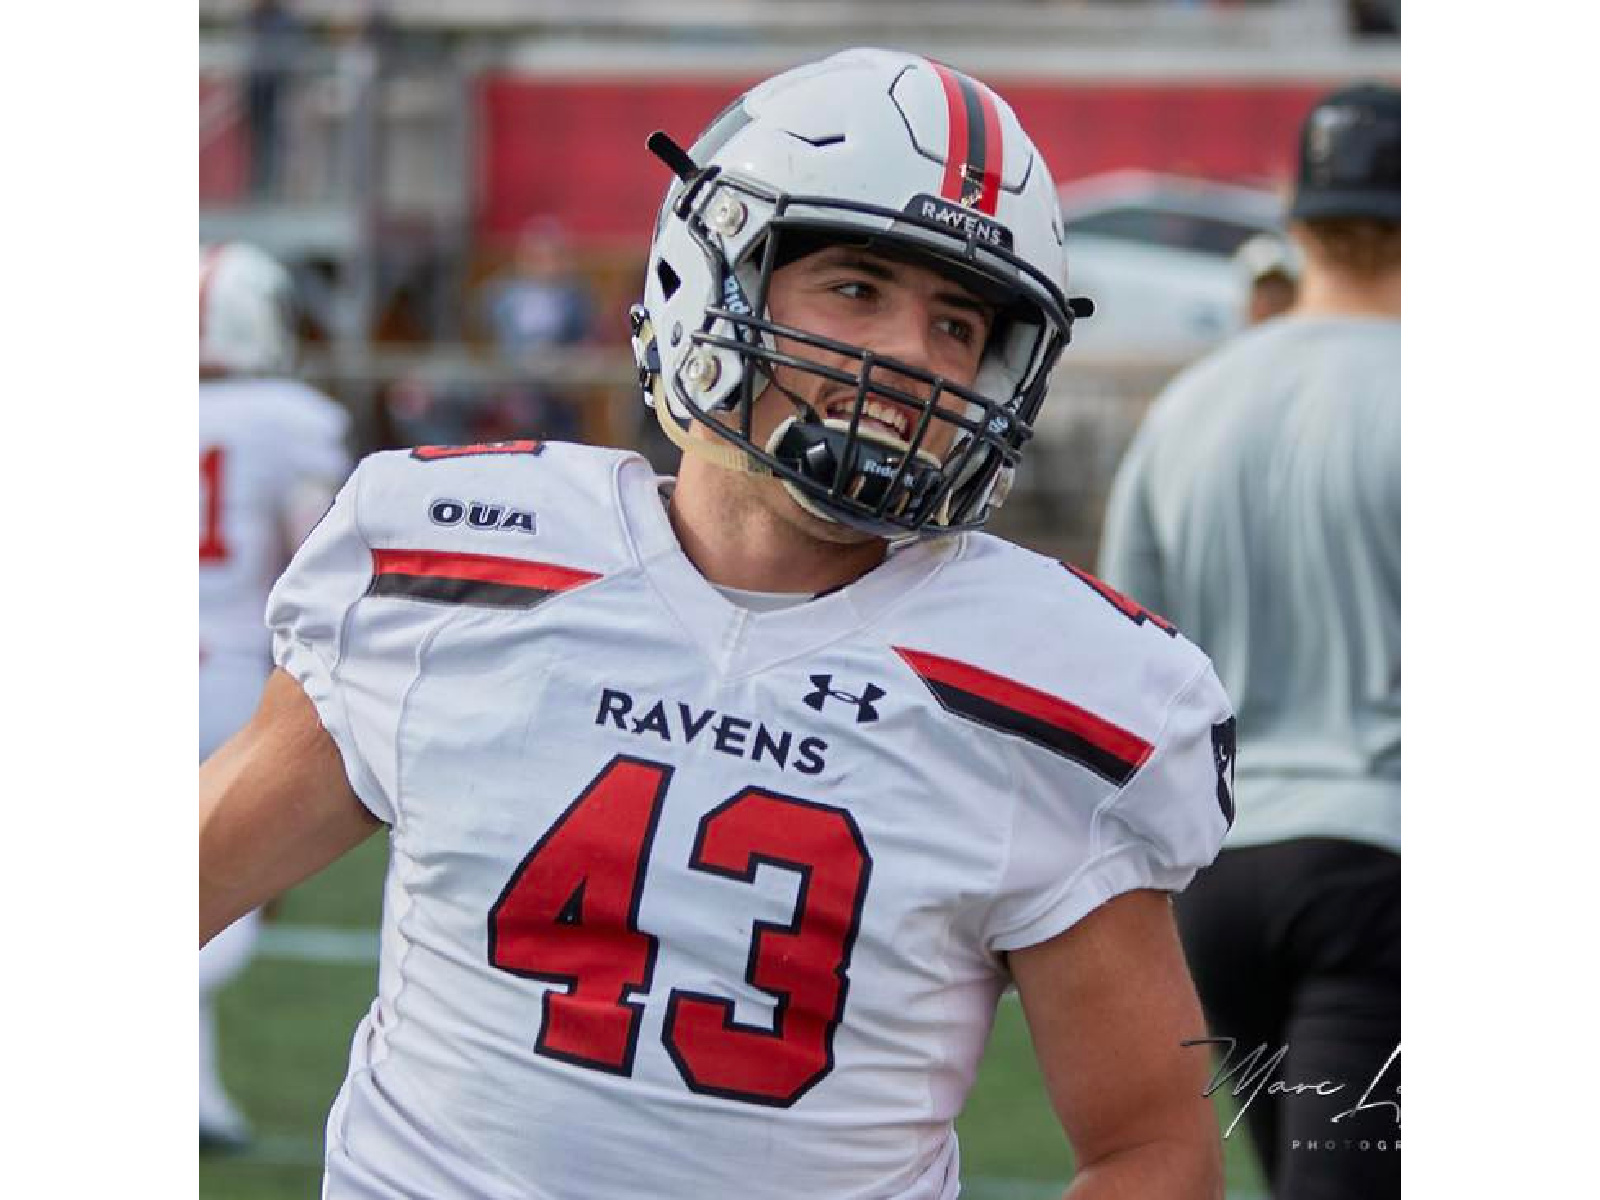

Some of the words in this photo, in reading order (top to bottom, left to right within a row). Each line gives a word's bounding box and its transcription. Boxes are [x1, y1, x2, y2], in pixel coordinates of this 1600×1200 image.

[921, 200, 1001, 246] RAVENS
[428, 498, 538, 535] OUA
[595, 687, 828, 775] RAVENS
[487, 753, 874, 1108] 43
